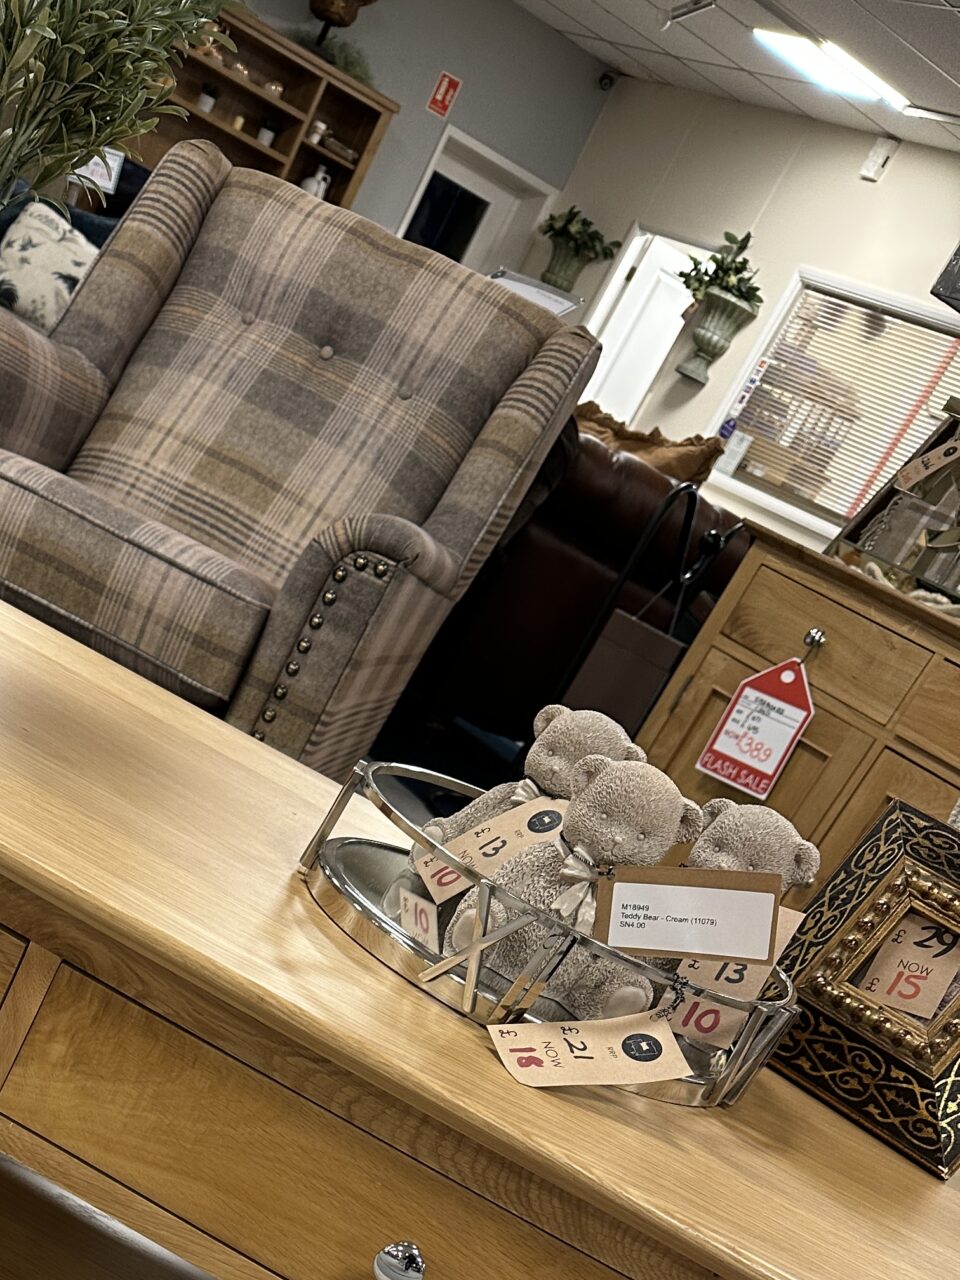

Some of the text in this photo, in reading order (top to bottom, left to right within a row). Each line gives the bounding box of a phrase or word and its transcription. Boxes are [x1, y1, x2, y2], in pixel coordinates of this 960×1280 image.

[702, 753, 772, 794] FLASH SALE
[478, 836, 508, 858] 13
[430, 865, 462, 887] 10
[621, 903, 650, 912] M18949
[620, 912, 641, 921] Teddy
[642, 913, 659, 921] Bear
[665, 915, 689, 924] Cream
[690, 917, 717, 927] (11079)
[891, 926, 959, 959] £ 29
[714, 962, 748, 984] 13
[896, 959, 934, 976] NOW
[865, 971, 928, 1000] £ 15
[681, 1001, 720, 1034] 10
[540, 1041, 565, 1069] NOW
[563, 1037, 594, 1061] 21
